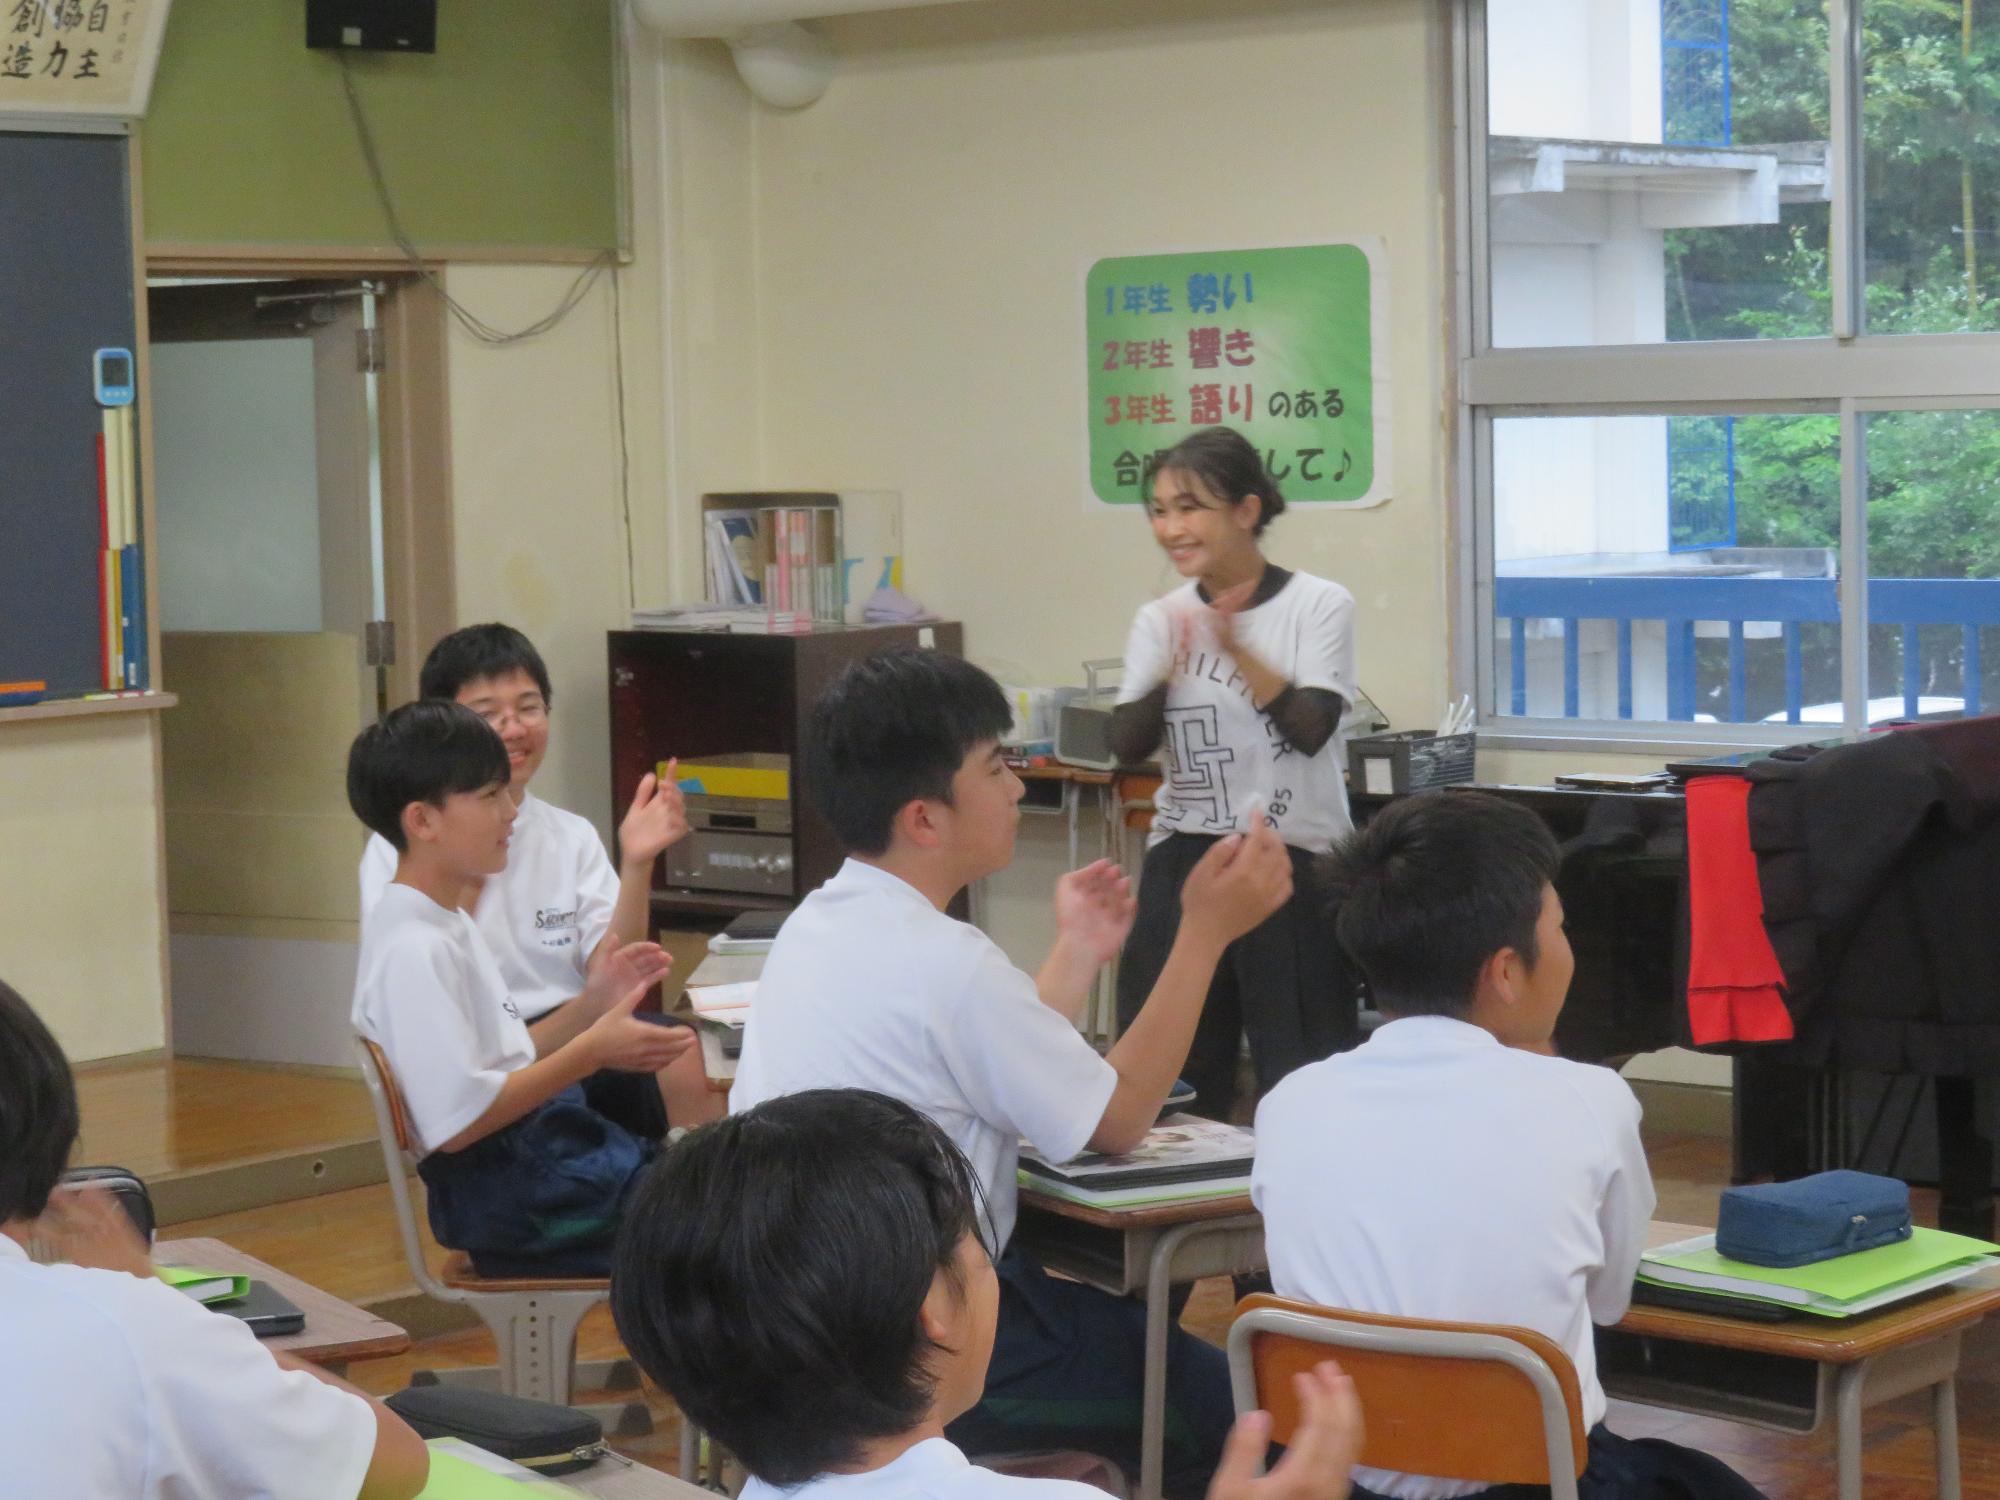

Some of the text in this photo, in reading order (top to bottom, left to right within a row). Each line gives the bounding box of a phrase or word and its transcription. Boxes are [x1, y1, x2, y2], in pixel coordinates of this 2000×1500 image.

[1, 0, 47, 79] 創造
[73, 1, 109, 79] 自主
[1104, 272, 1254, 316] 1年生 勢い
[1102, 327, 1255, 371] 2年生 響き
[1104, 384, 1345, 426] 3年生 語り のある
